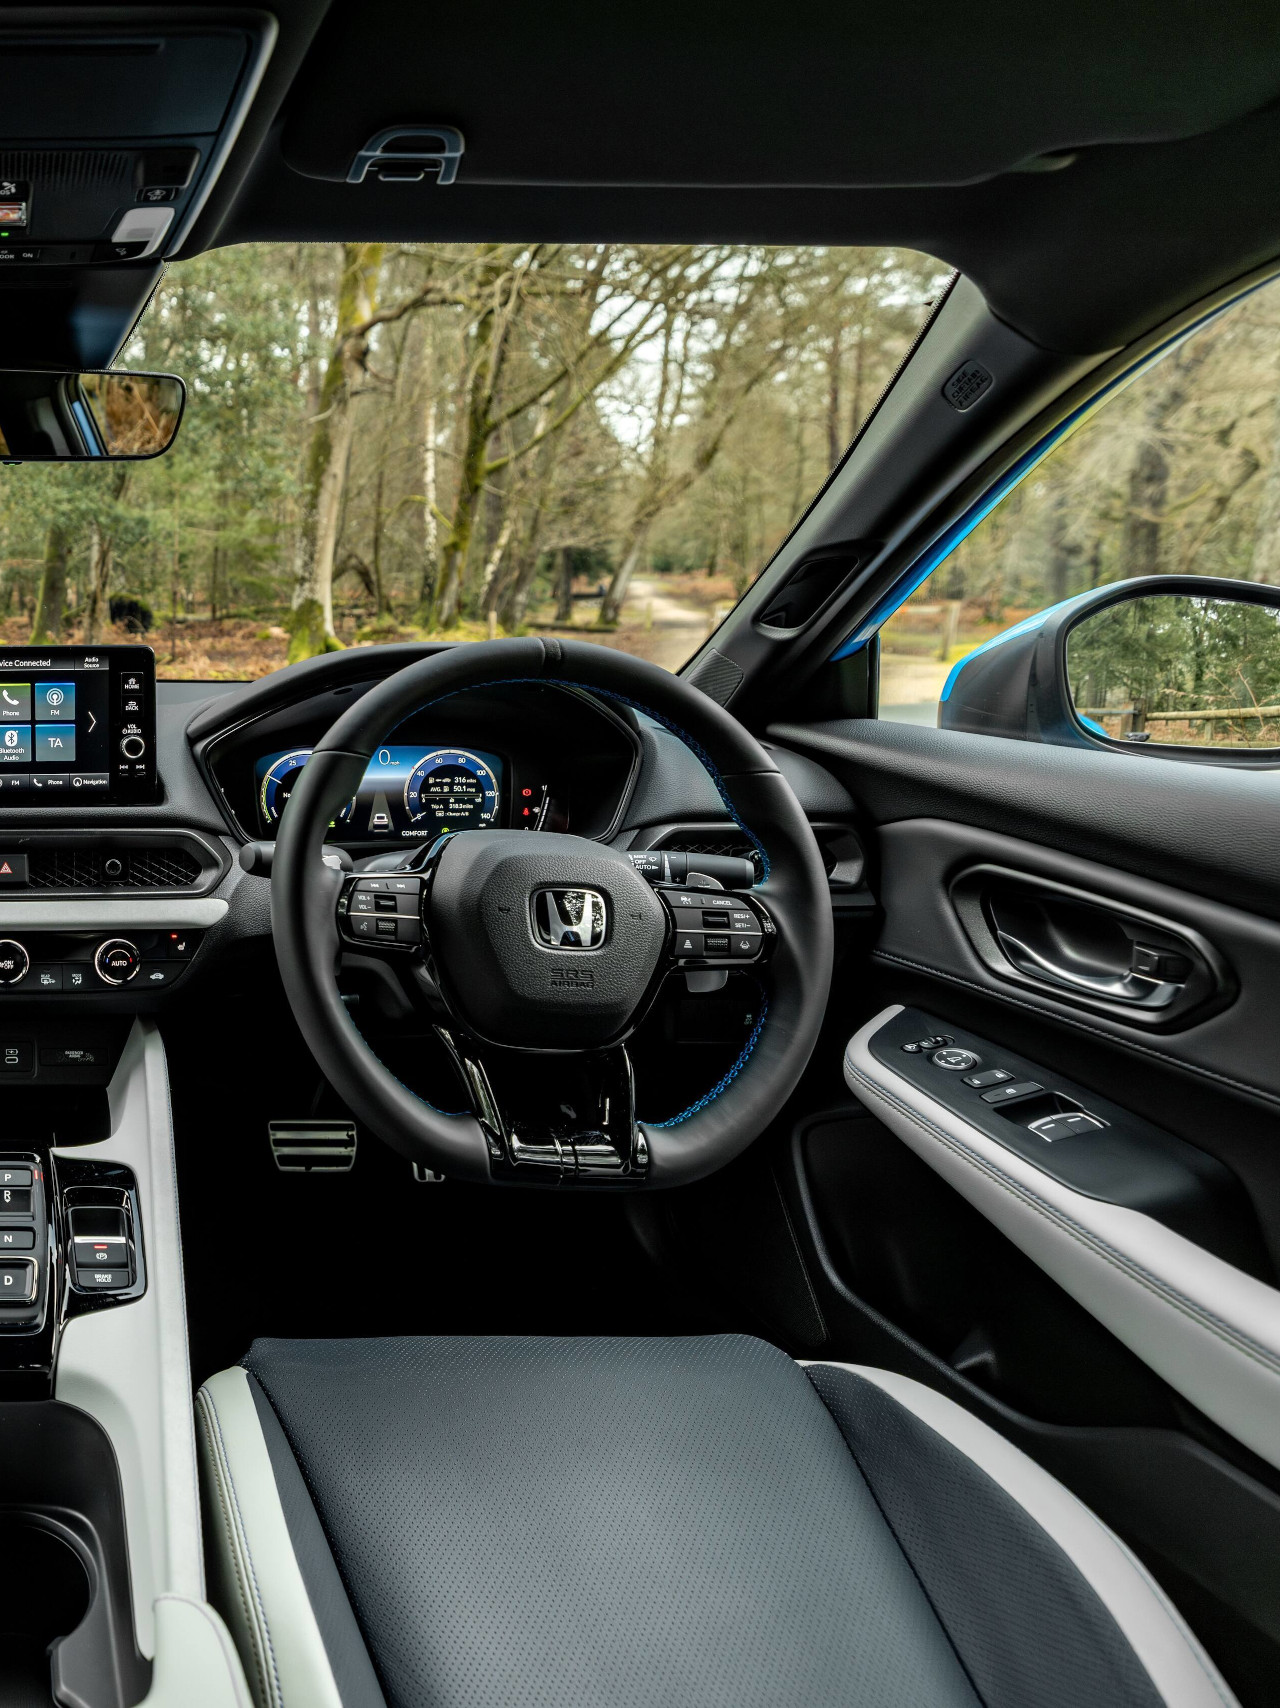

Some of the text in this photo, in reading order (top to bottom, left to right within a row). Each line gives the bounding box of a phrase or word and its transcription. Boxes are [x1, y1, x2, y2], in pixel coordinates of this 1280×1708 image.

[14, 659, 51, 667] Connected
[48, 738, 63, 748] TA
[378, 749, 391, 766] 0
[550, 968, 594, 979] SRS
[550, 980, 594, 989] AIRBAG
[4, 1173, 12, 1182] P
[4, 1190, 11, 1200] R
[4, 1235, 13, 1243] N
[4, 1275, 13, 1286] D
